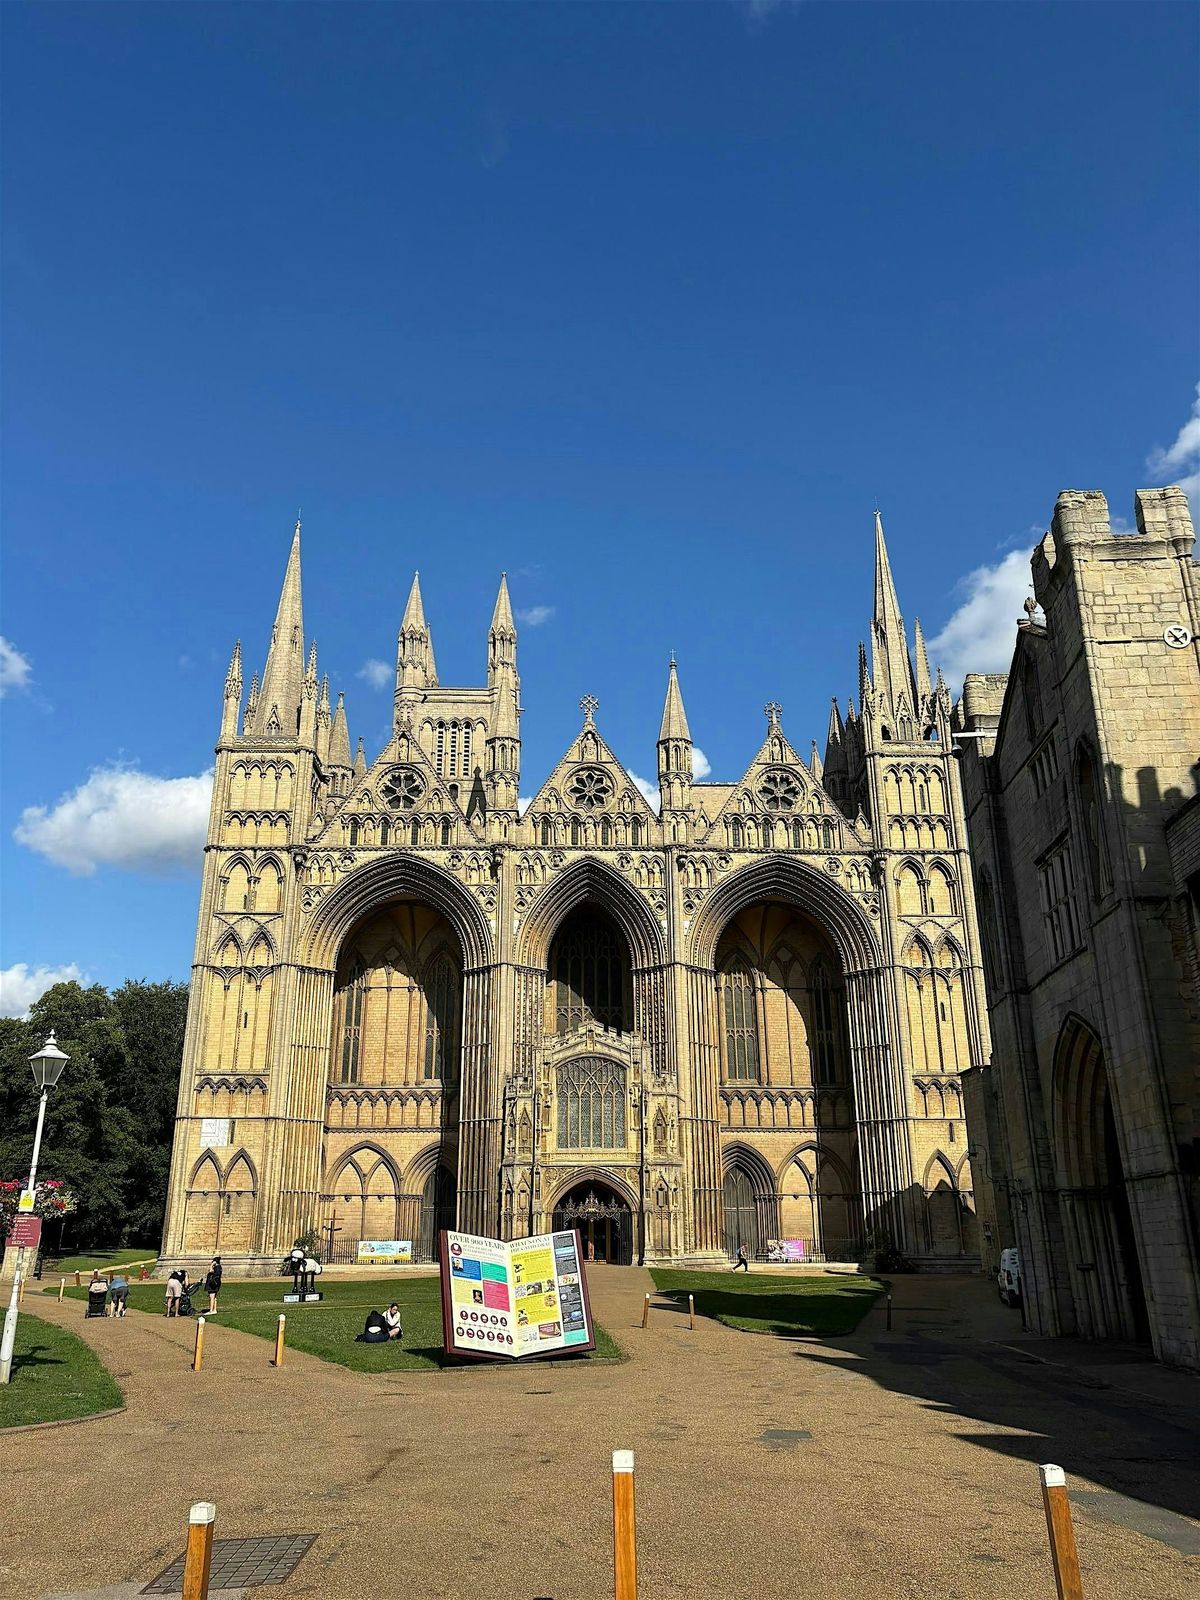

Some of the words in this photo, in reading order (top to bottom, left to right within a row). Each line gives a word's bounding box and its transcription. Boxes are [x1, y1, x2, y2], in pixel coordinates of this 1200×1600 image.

[449, 1234, 470, 1244] OVER
[470, 1239, 484, 1247] 900
[484, 1240, 506, 1251] YEARS
